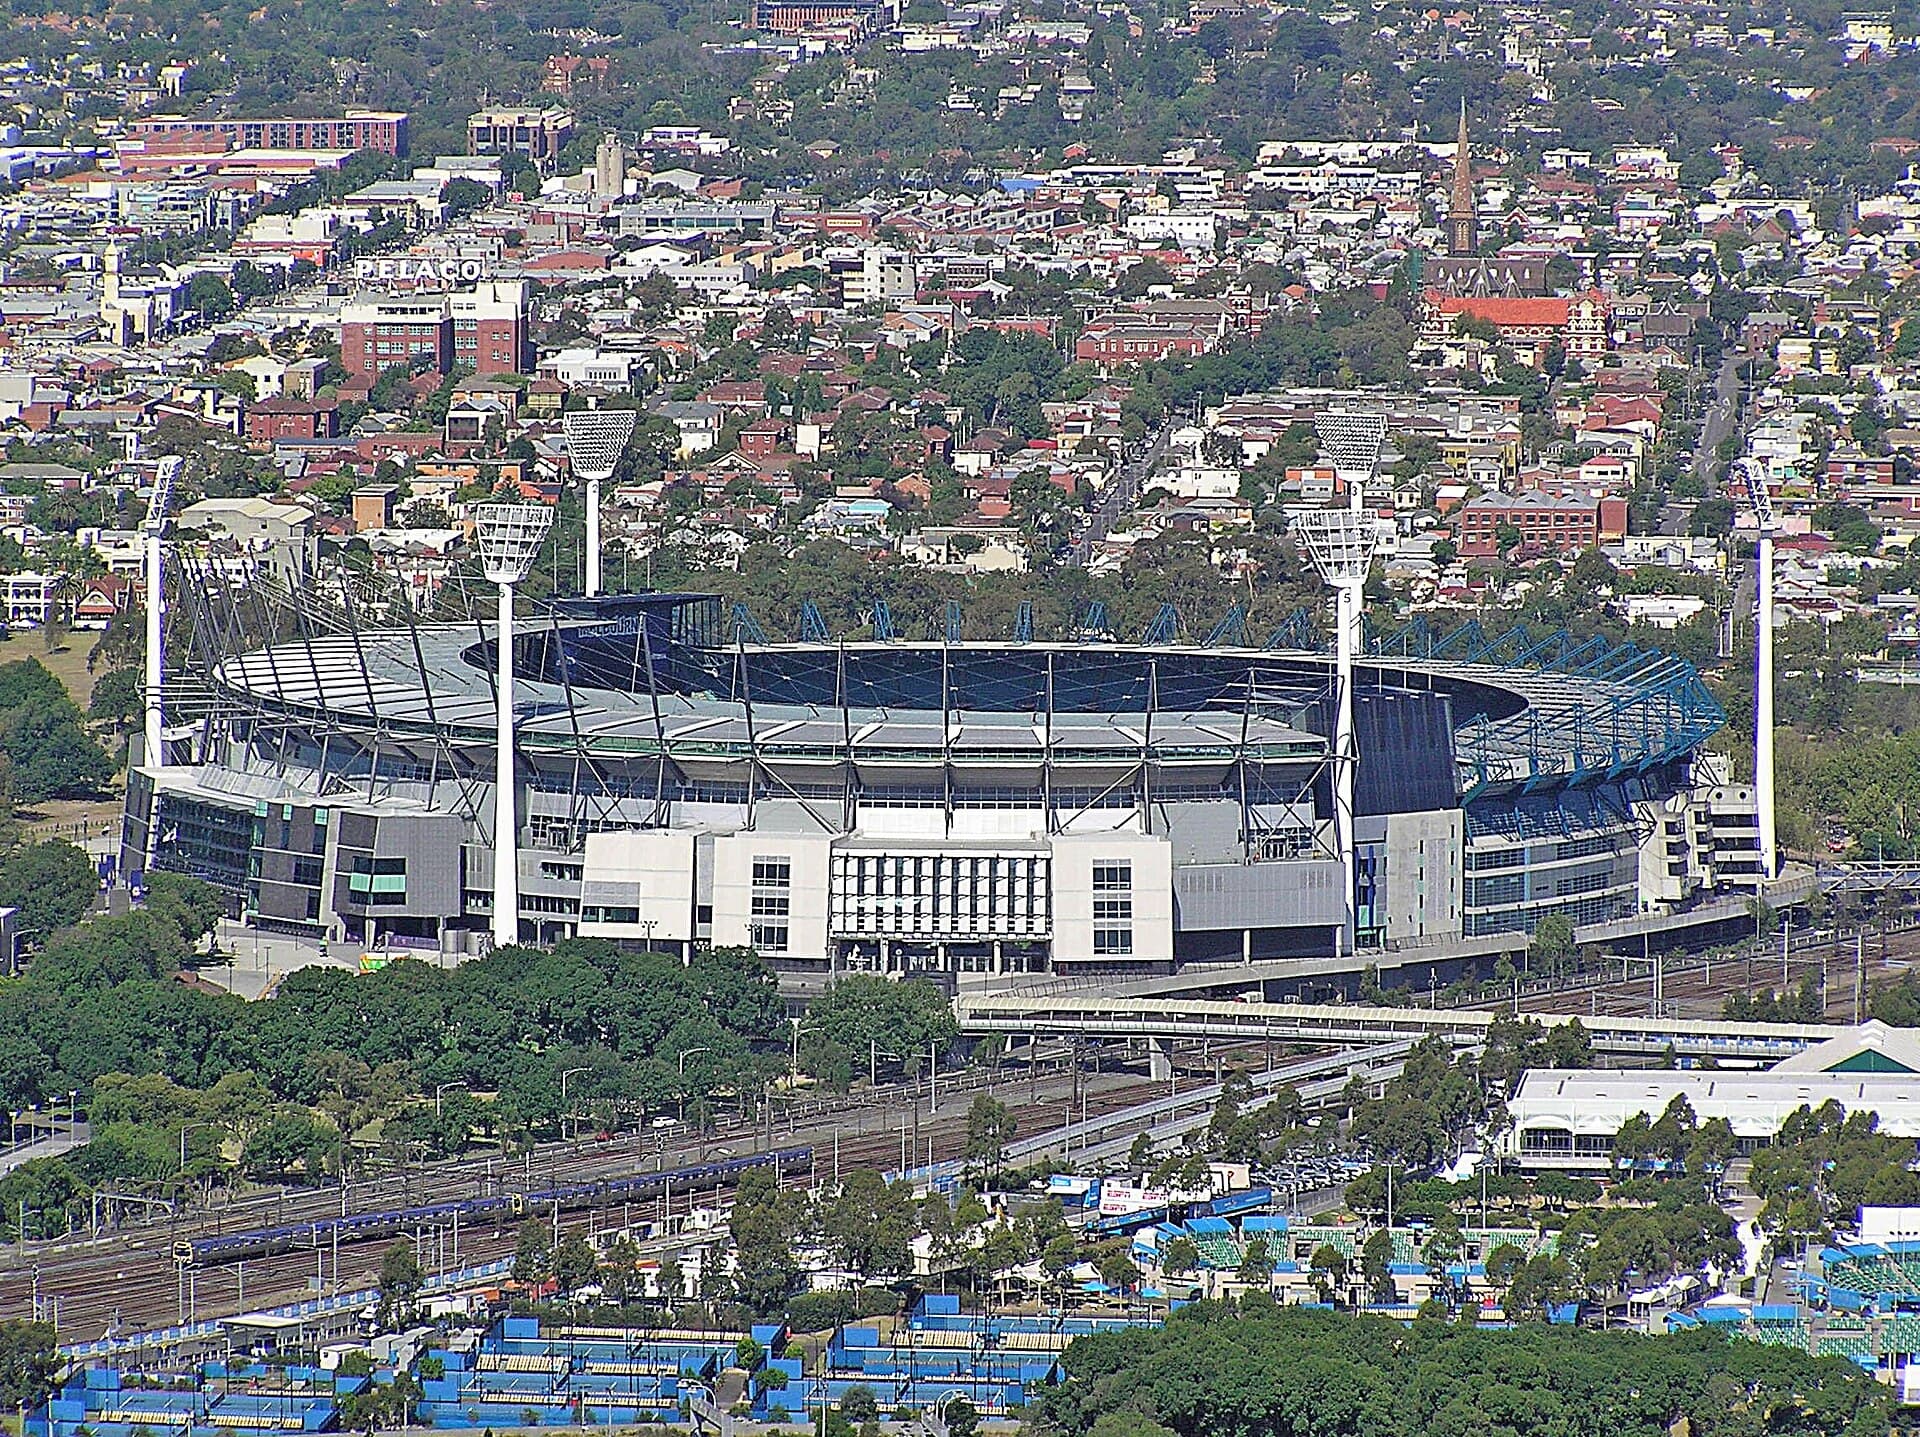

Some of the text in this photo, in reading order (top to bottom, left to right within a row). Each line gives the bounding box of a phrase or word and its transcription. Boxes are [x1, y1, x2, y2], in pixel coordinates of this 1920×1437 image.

[356, 260, 481, 281] PELACO
[1343, 593, 1351, 603] 5
[578, 616, 645, 638] MELBOURN
